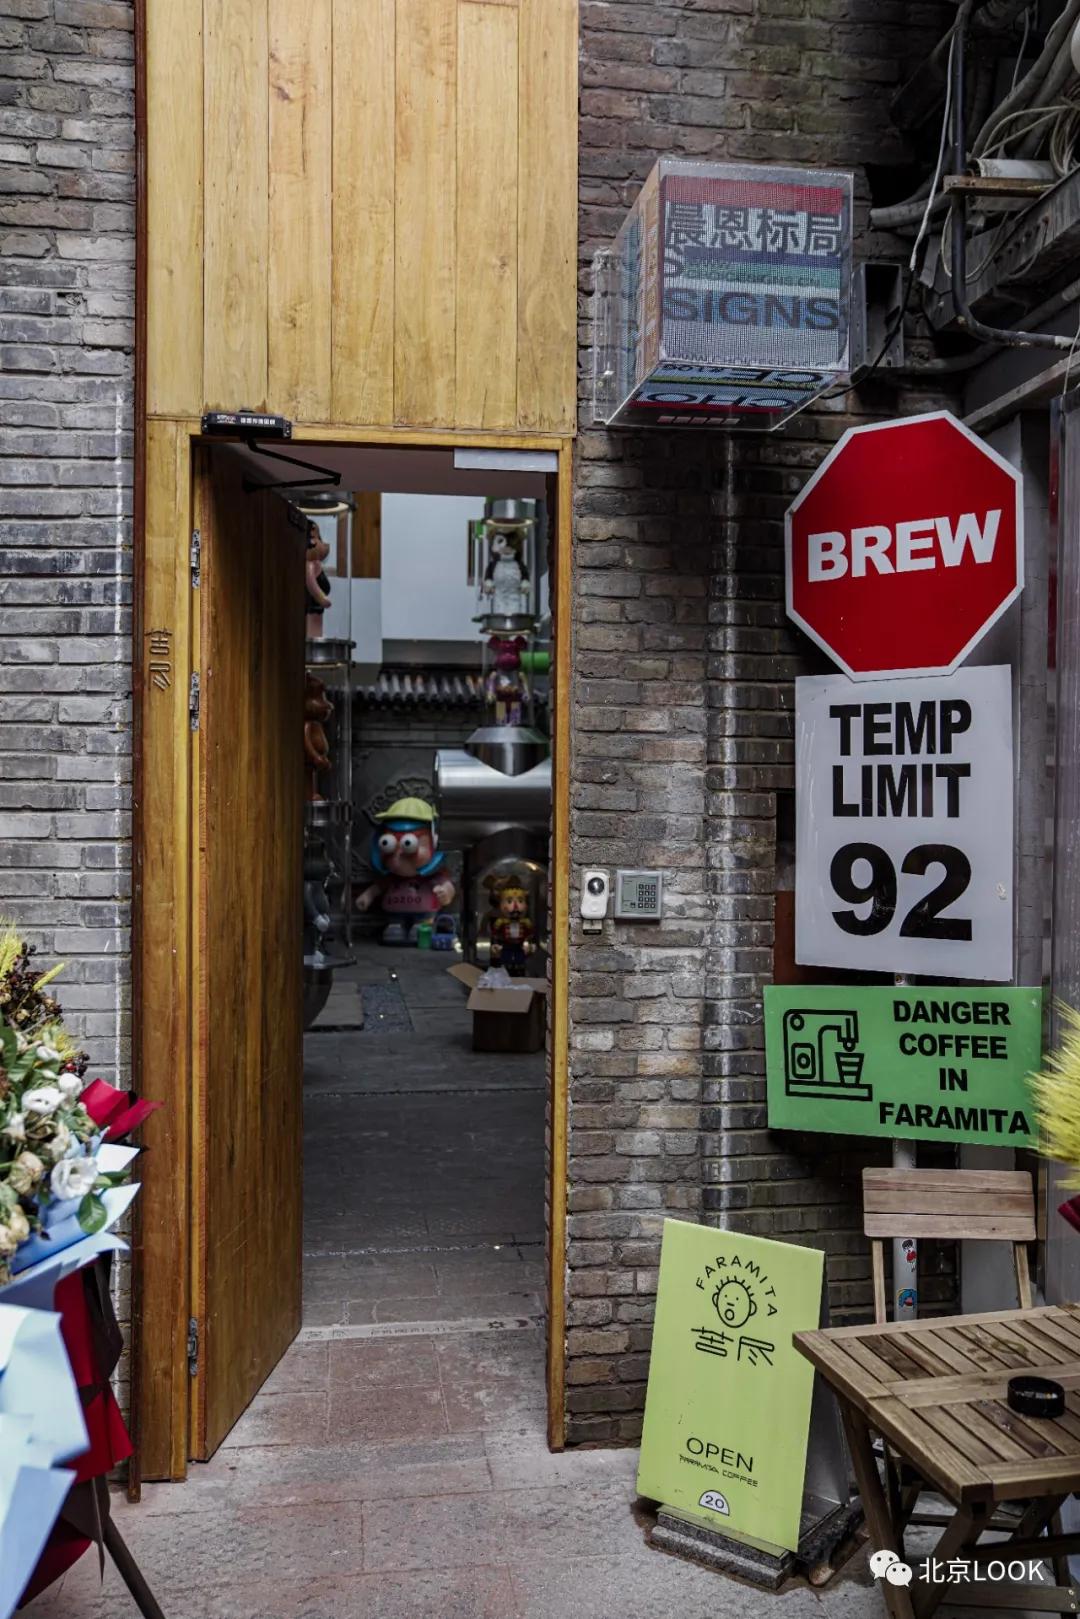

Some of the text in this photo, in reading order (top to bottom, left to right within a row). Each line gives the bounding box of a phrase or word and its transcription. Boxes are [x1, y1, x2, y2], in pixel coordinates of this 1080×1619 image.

[663, 287, 840, 331] SIGNS
[807, 509, 1002, 583] BREW
[829, 699, 972, 756] TEMP
[832, 762, 971, 818] LIMIT
[830, 842, 973, 941] 92
[893, 1000, 1012, 1025] DANGER
[899, 1032, 1008, 1060] COFFEE
[939, 1067, 968, 1092] IN
[879, 1102, 1031, 1136] FARAMITA
[695, 1255, 778, 1316] FARAMITA
[686, 1437, 754, 1473] OPEN
[722, 1469, 759, 1488] COFFEE
[705, 1494, 725, 1510] 20
